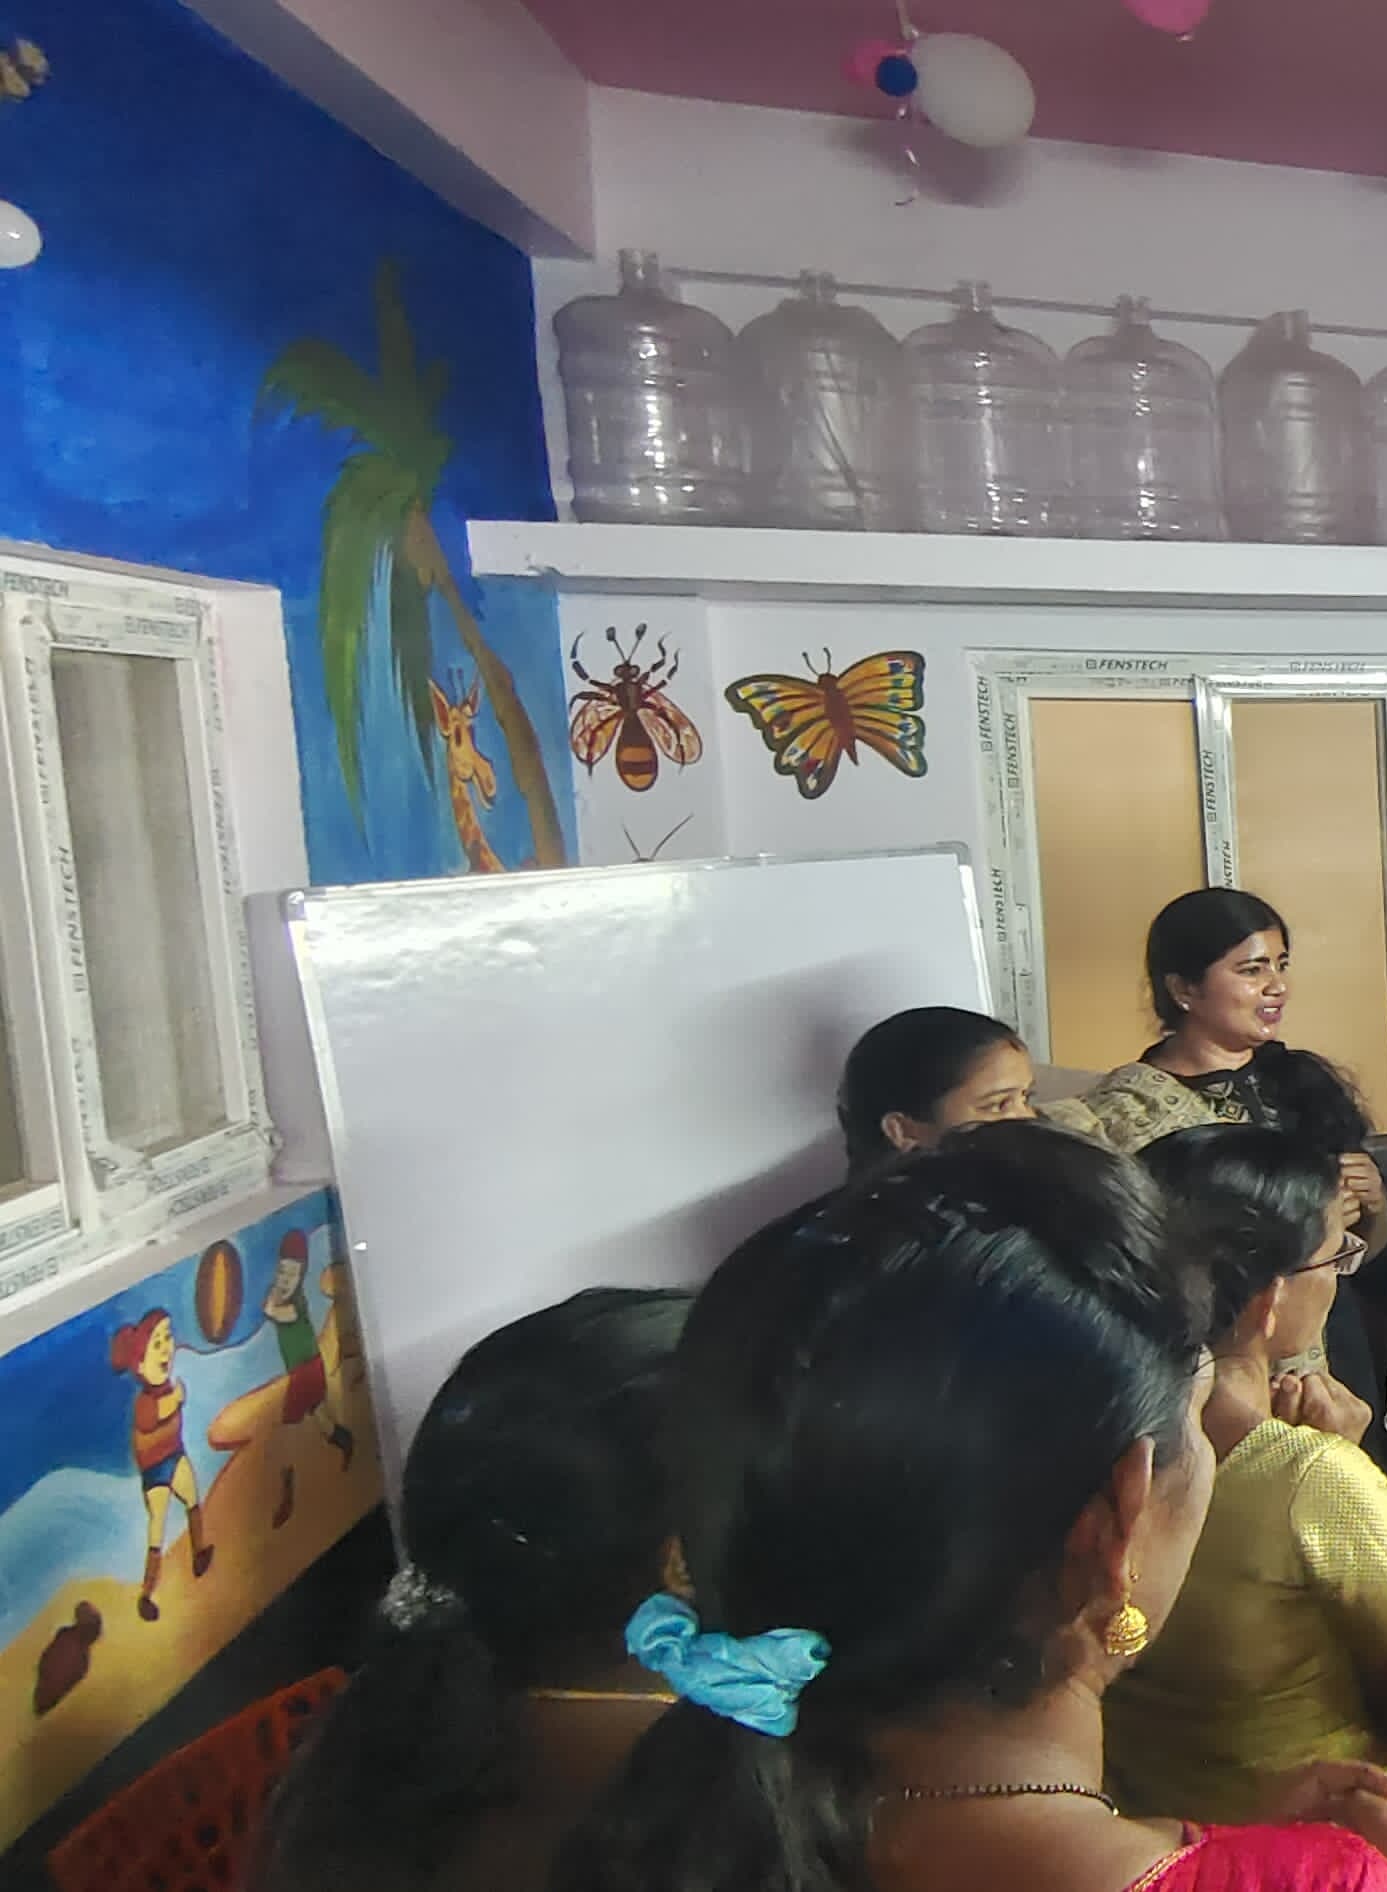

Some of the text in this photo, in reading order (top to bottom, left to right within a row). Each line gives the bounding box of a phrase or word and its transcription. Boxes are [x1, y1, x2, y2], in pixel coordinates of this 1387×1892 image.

[632, 553, 662, 585] of
[1100, 659, 1168, 671] FENSTECH
[977, 676, 991, 740] FENSTECH
[1004, 712, 1018, 779] FENSTECH
[1203, 750, 1217, 811] FENSTECH
